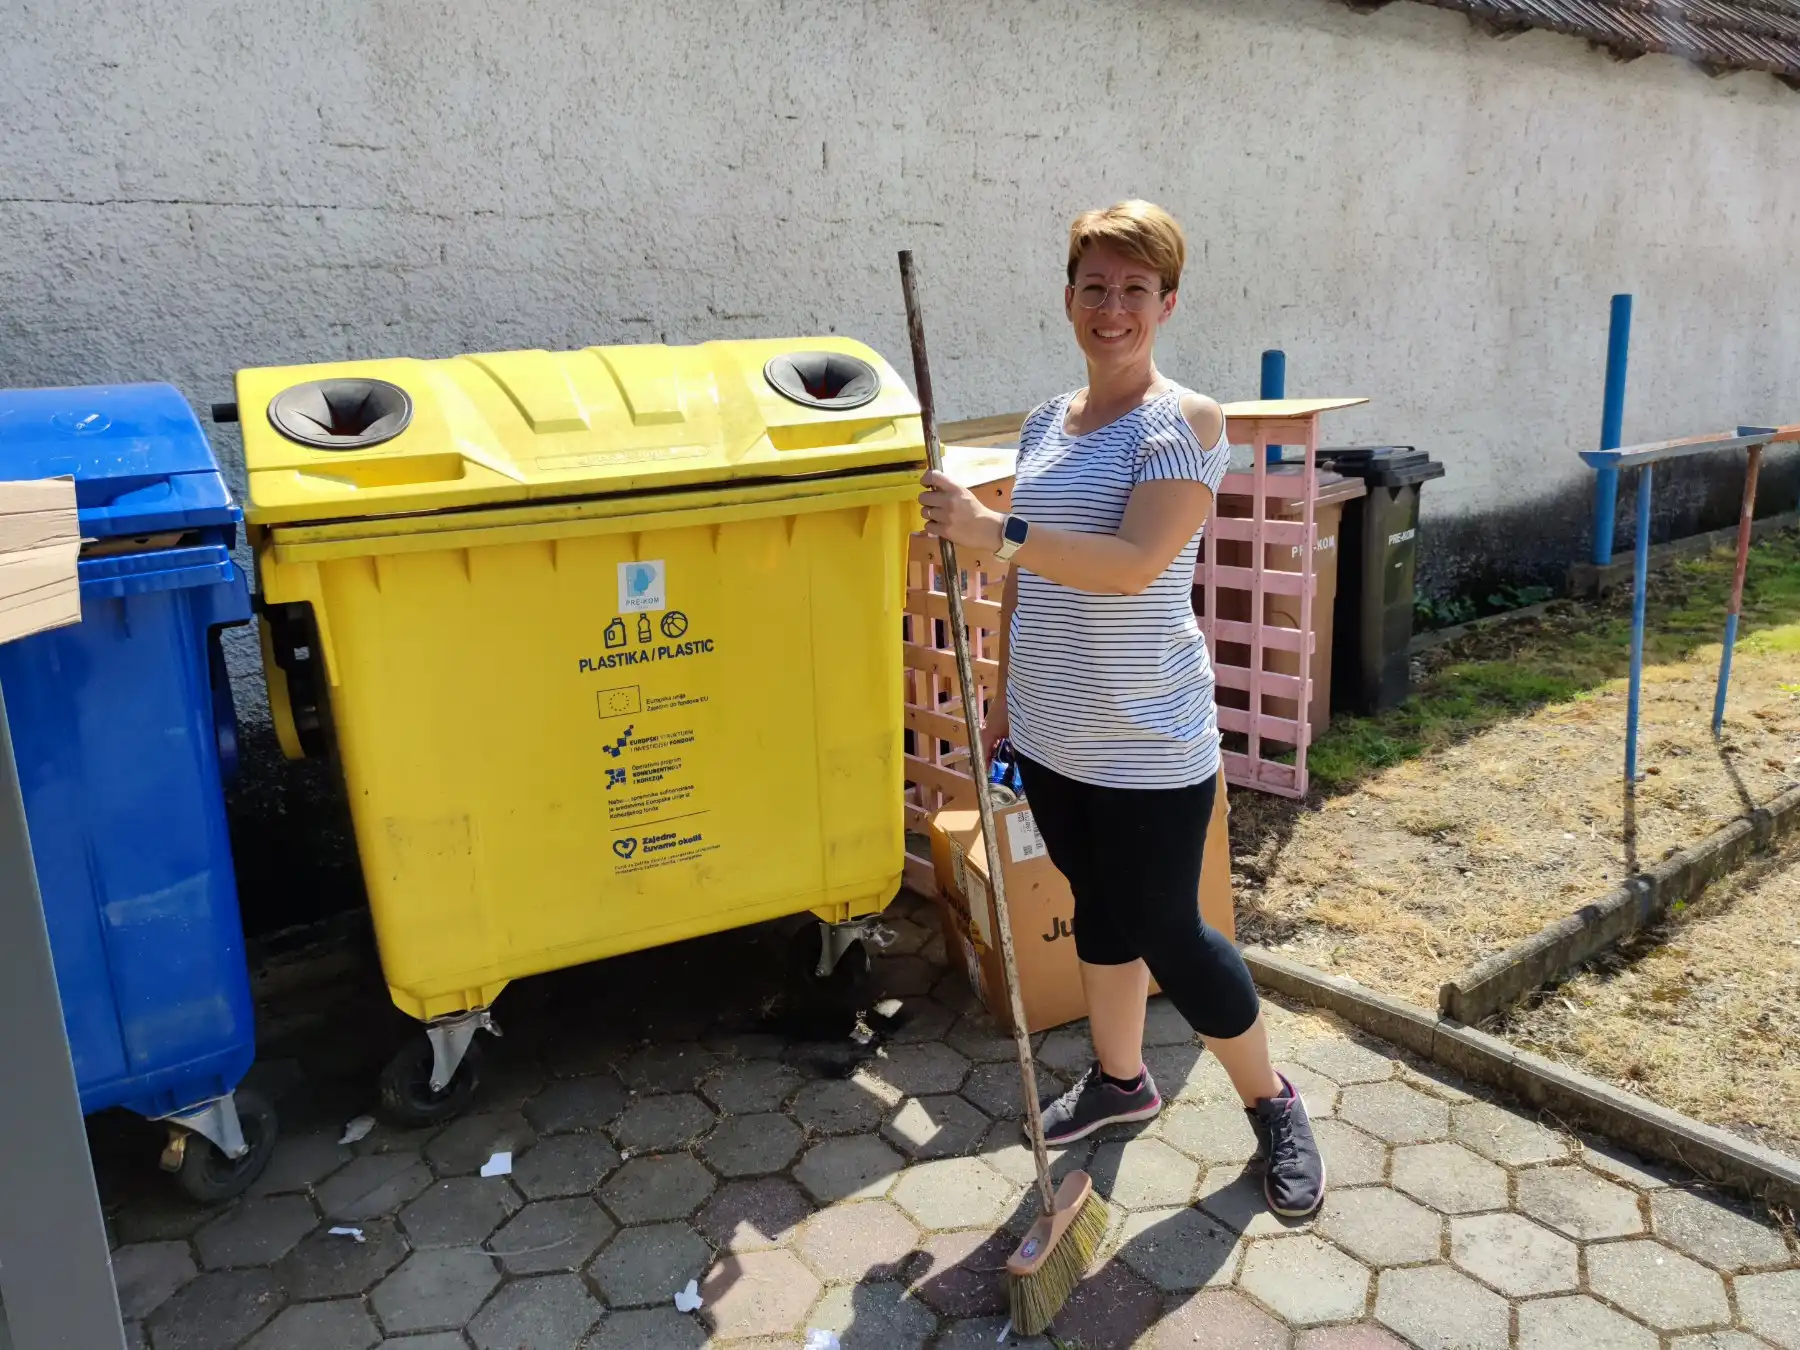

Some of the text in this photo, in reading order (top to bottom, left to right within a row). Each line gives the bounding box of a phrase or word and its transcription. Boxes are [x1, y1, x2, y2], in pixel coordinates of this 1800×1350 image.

[1291, 535, 1335, 558] P-KOM
[625, 597, 660, 606] PRE-KOM
[578, 650, 650, 673] PLASTIKA
[657, 639, 714, 660] PLASTIC
[642, 832, 677, 845] Zajedno
[643, 833, 703, 854] čuvamo okoliš
